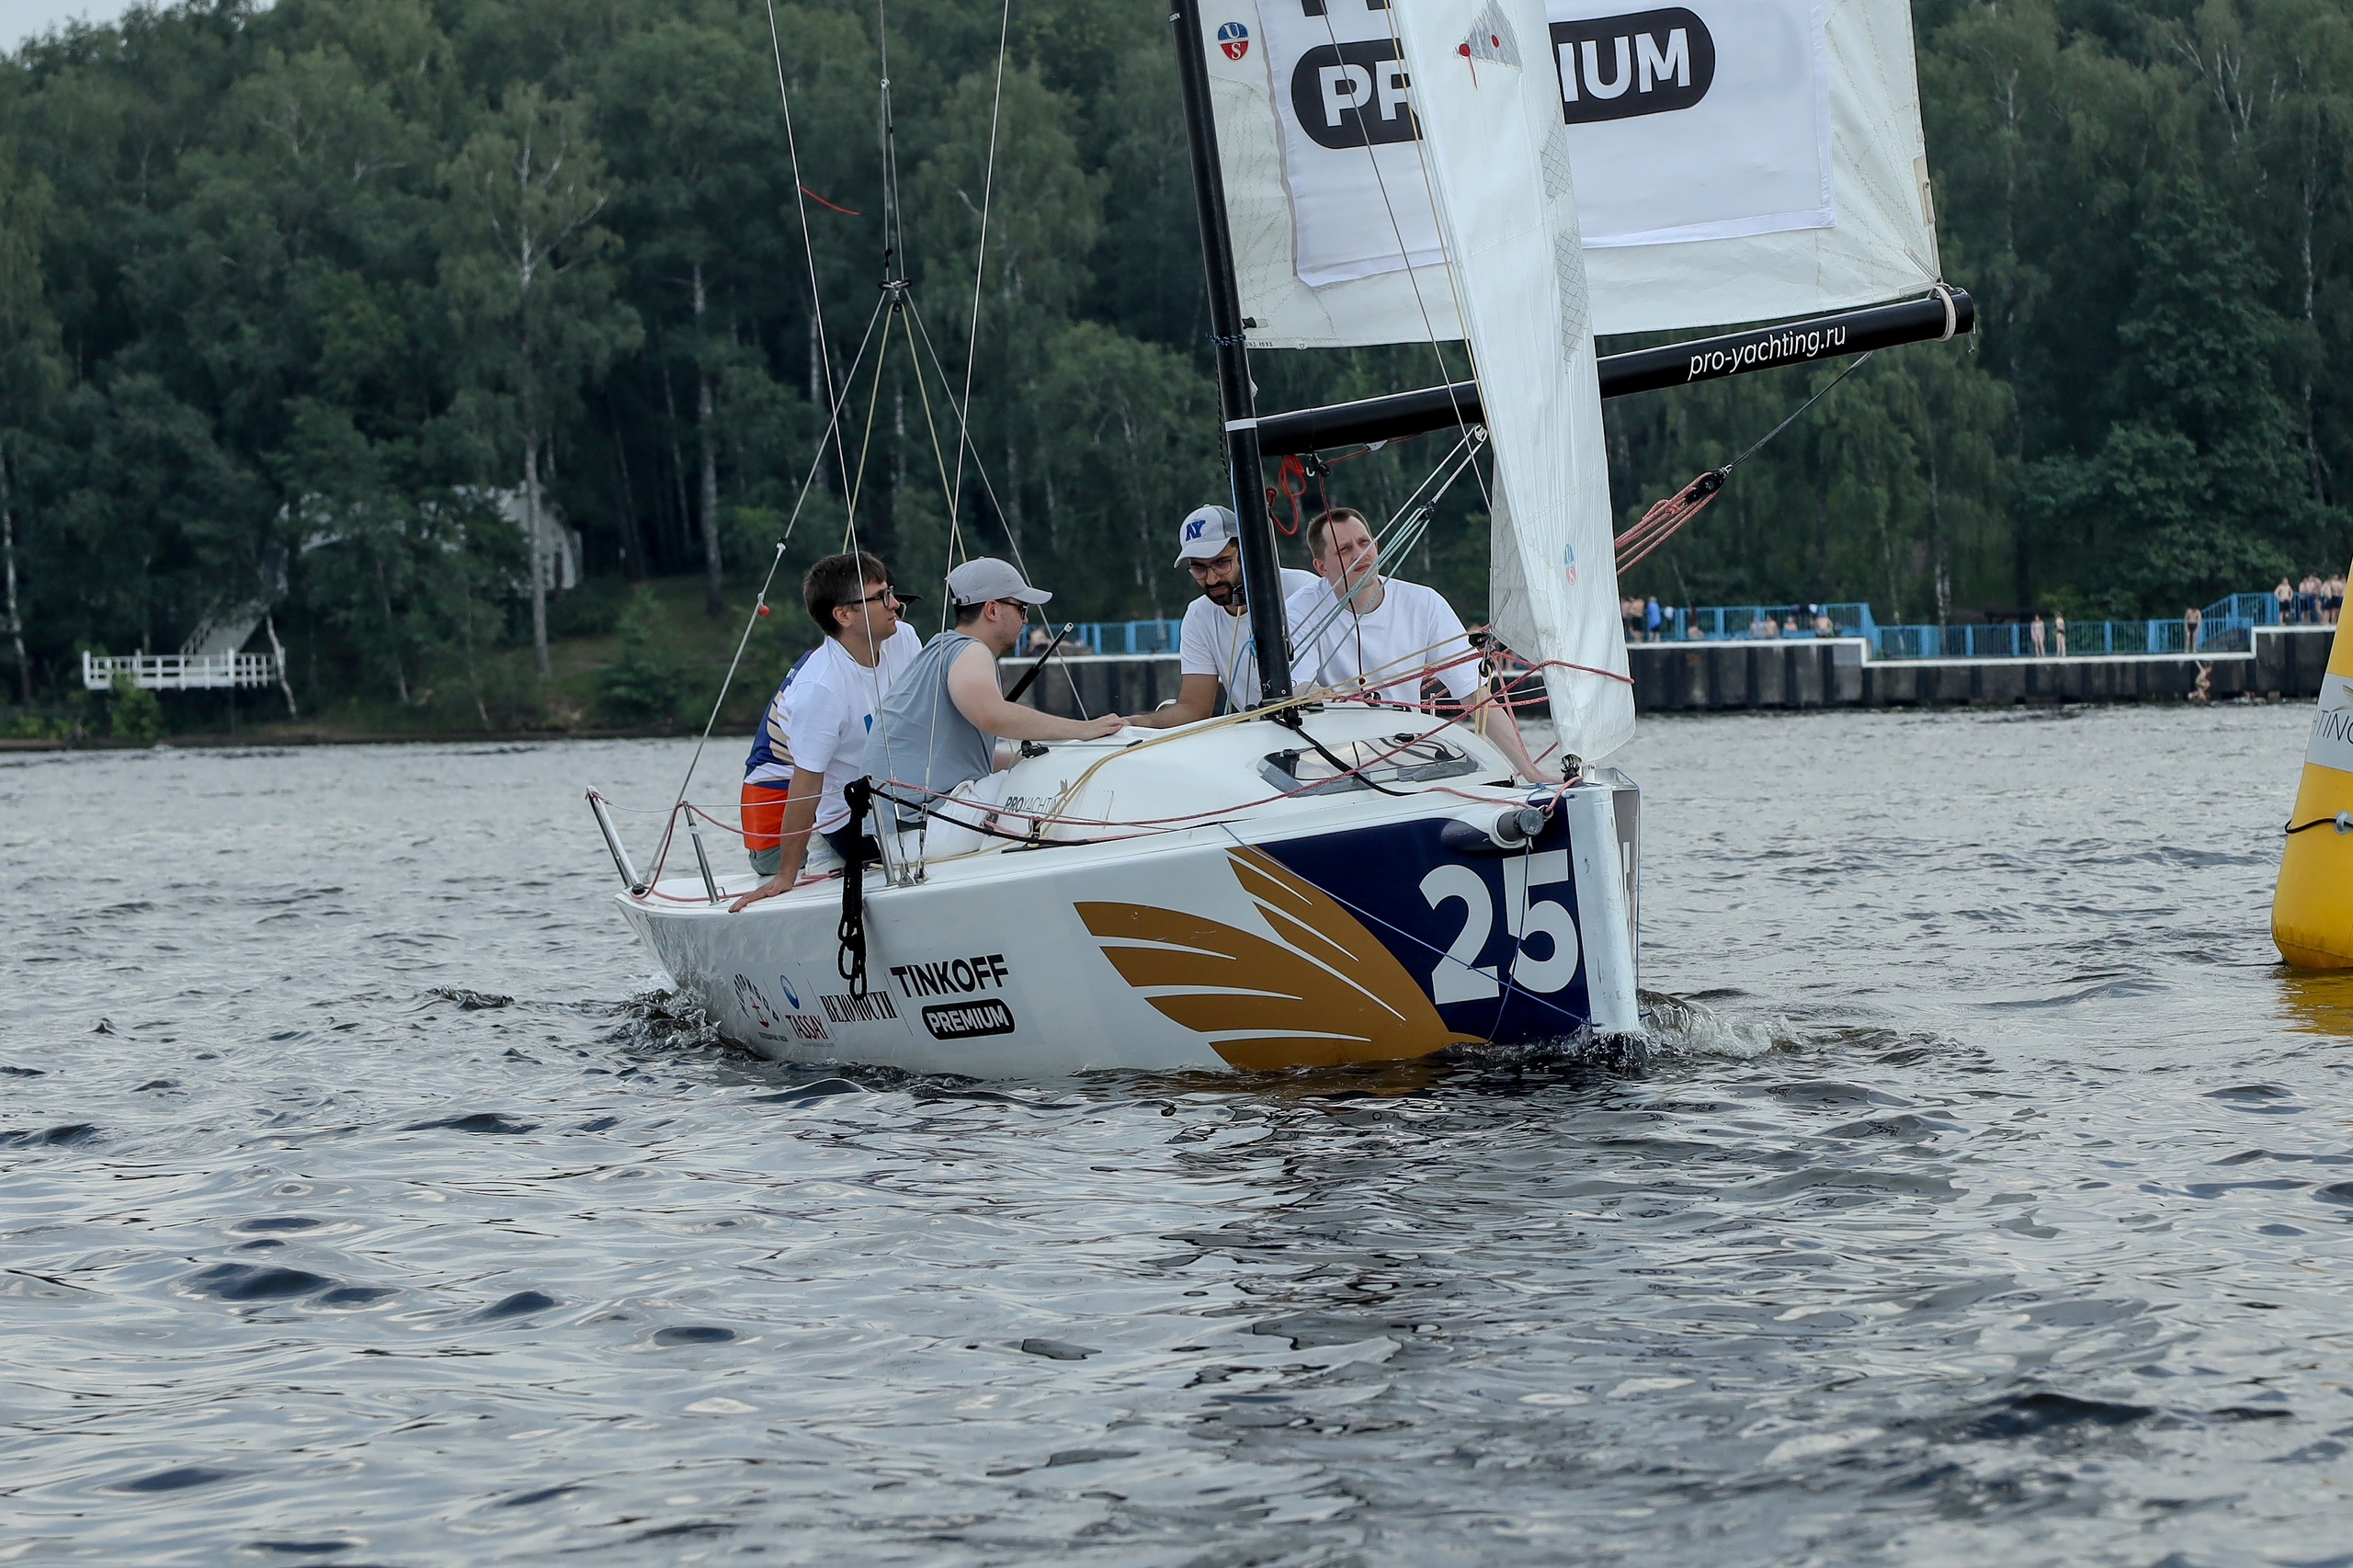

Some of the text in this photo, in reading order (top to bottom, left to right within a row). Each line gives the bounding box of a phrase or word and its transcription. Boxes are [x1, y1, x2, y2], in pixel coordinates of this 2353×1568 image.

[1318, 28, 1691, 128] PRIUM
[1688, 325, 1846, 381] pro-yachting.ru
[1418, 848, 1578, 1005] 25
[889, 953, 1009, 998] TINKOFF
[785, 1015, 829, 1040] TASSAY
[926, 1005, 1010, 1033] PREMIUM
